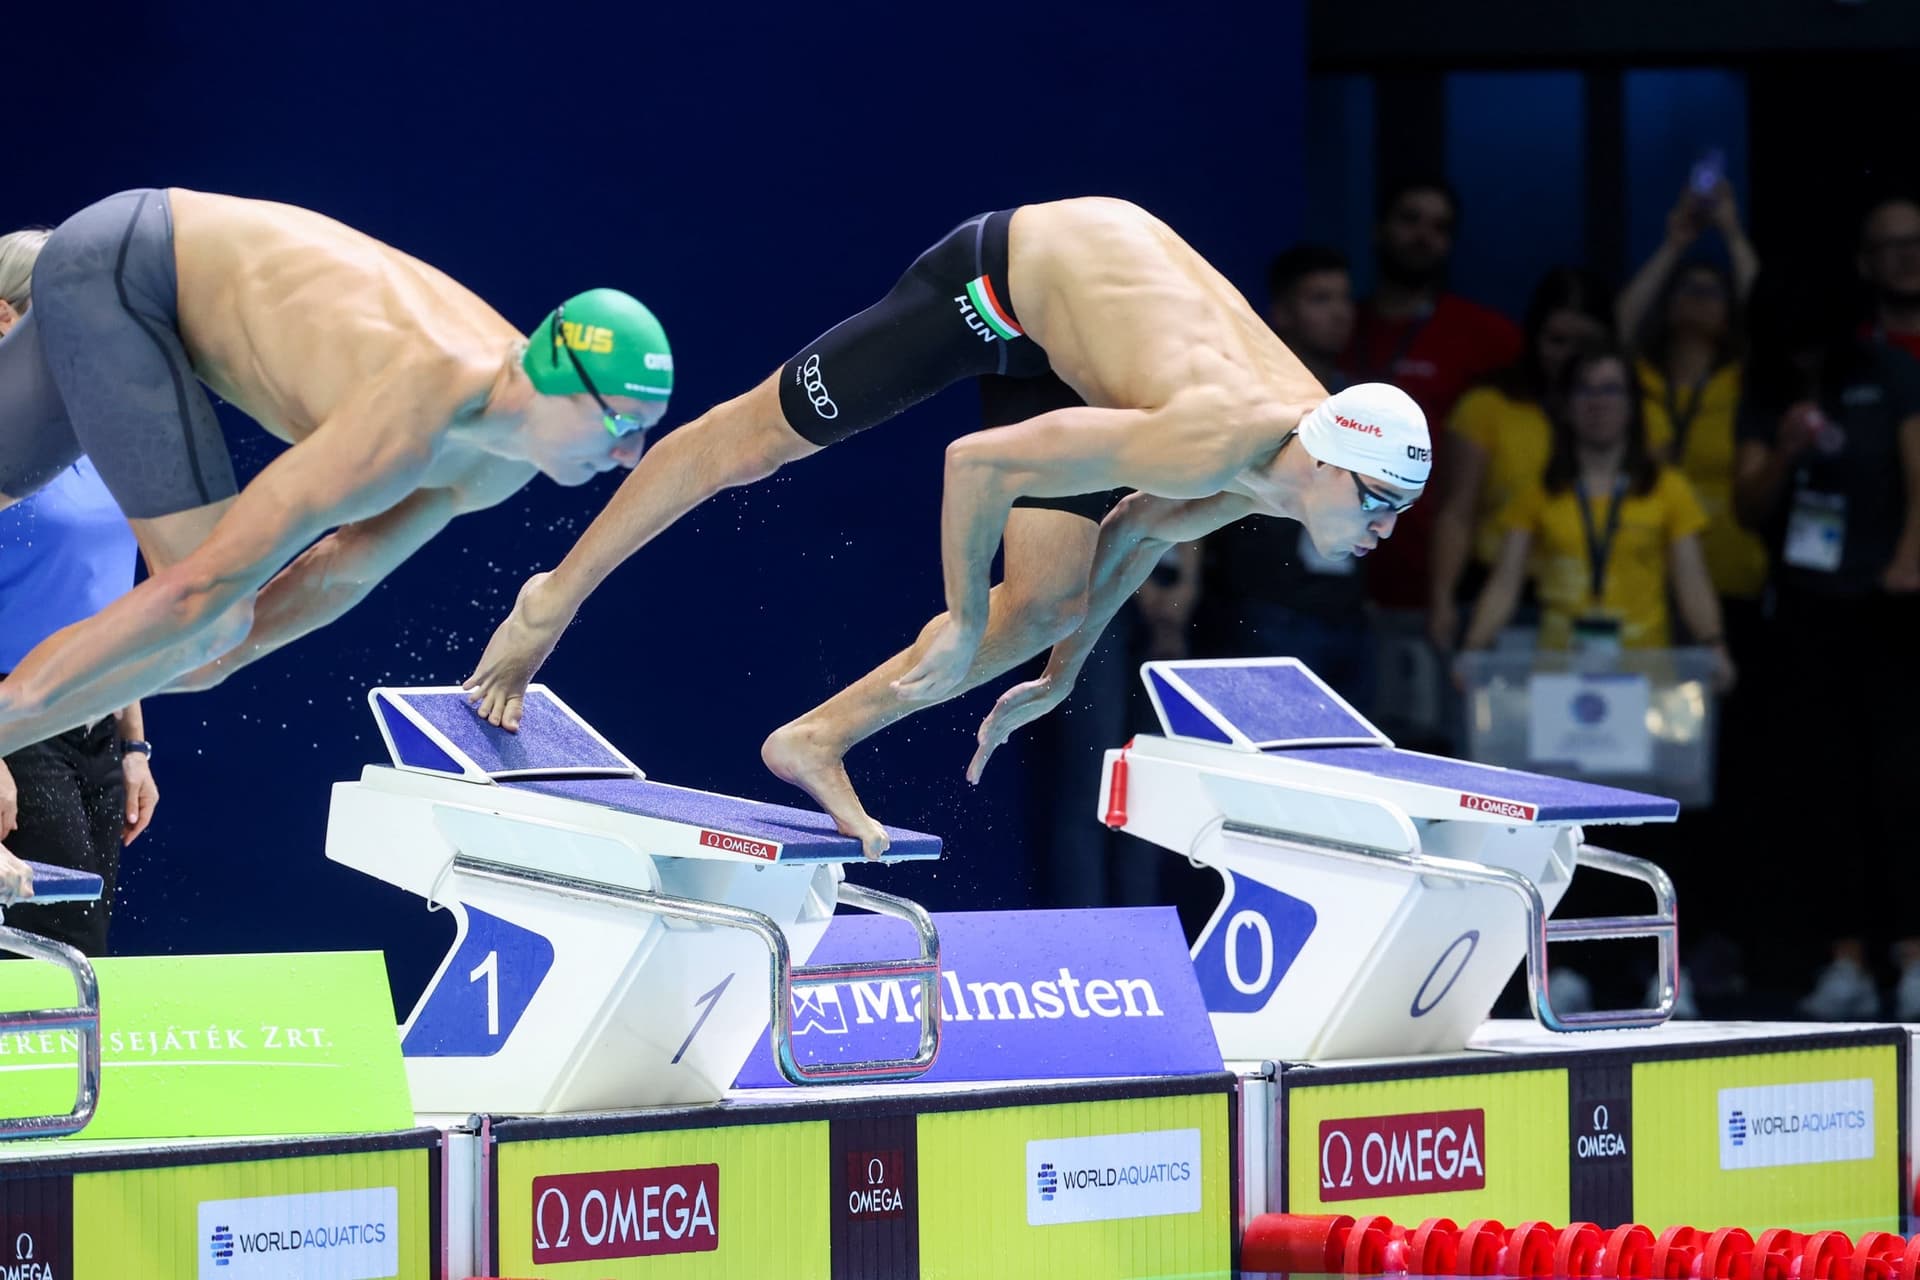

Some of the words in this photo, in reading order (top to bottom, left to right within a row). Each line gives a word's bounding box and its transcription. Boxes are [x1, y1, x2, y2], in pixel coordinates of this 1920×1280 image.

[954, 295, 998, 342] HUN
[1335, 415, 1384, 438] Yakult
[1481, 800, 1526, 818] OMEGA
[722, 837, 769, 857] OMEGA
[1224, 910, 1274, 995] 0
[1410, 929, 1480, 1018] 0
[470, 950, 499, 1035] 1
[0, 1025, 248, 1056] ERENSEJÁTÉK
[670, 972, 736, 1064] 1
[1361, 1124, 1483, 1186] OMEGA
[1577, 1133, 1626, 1158] OMEGA
[580, 1180, 716, 1245] OMEGA
[849, 1188, 903, 1214] OMEGA
